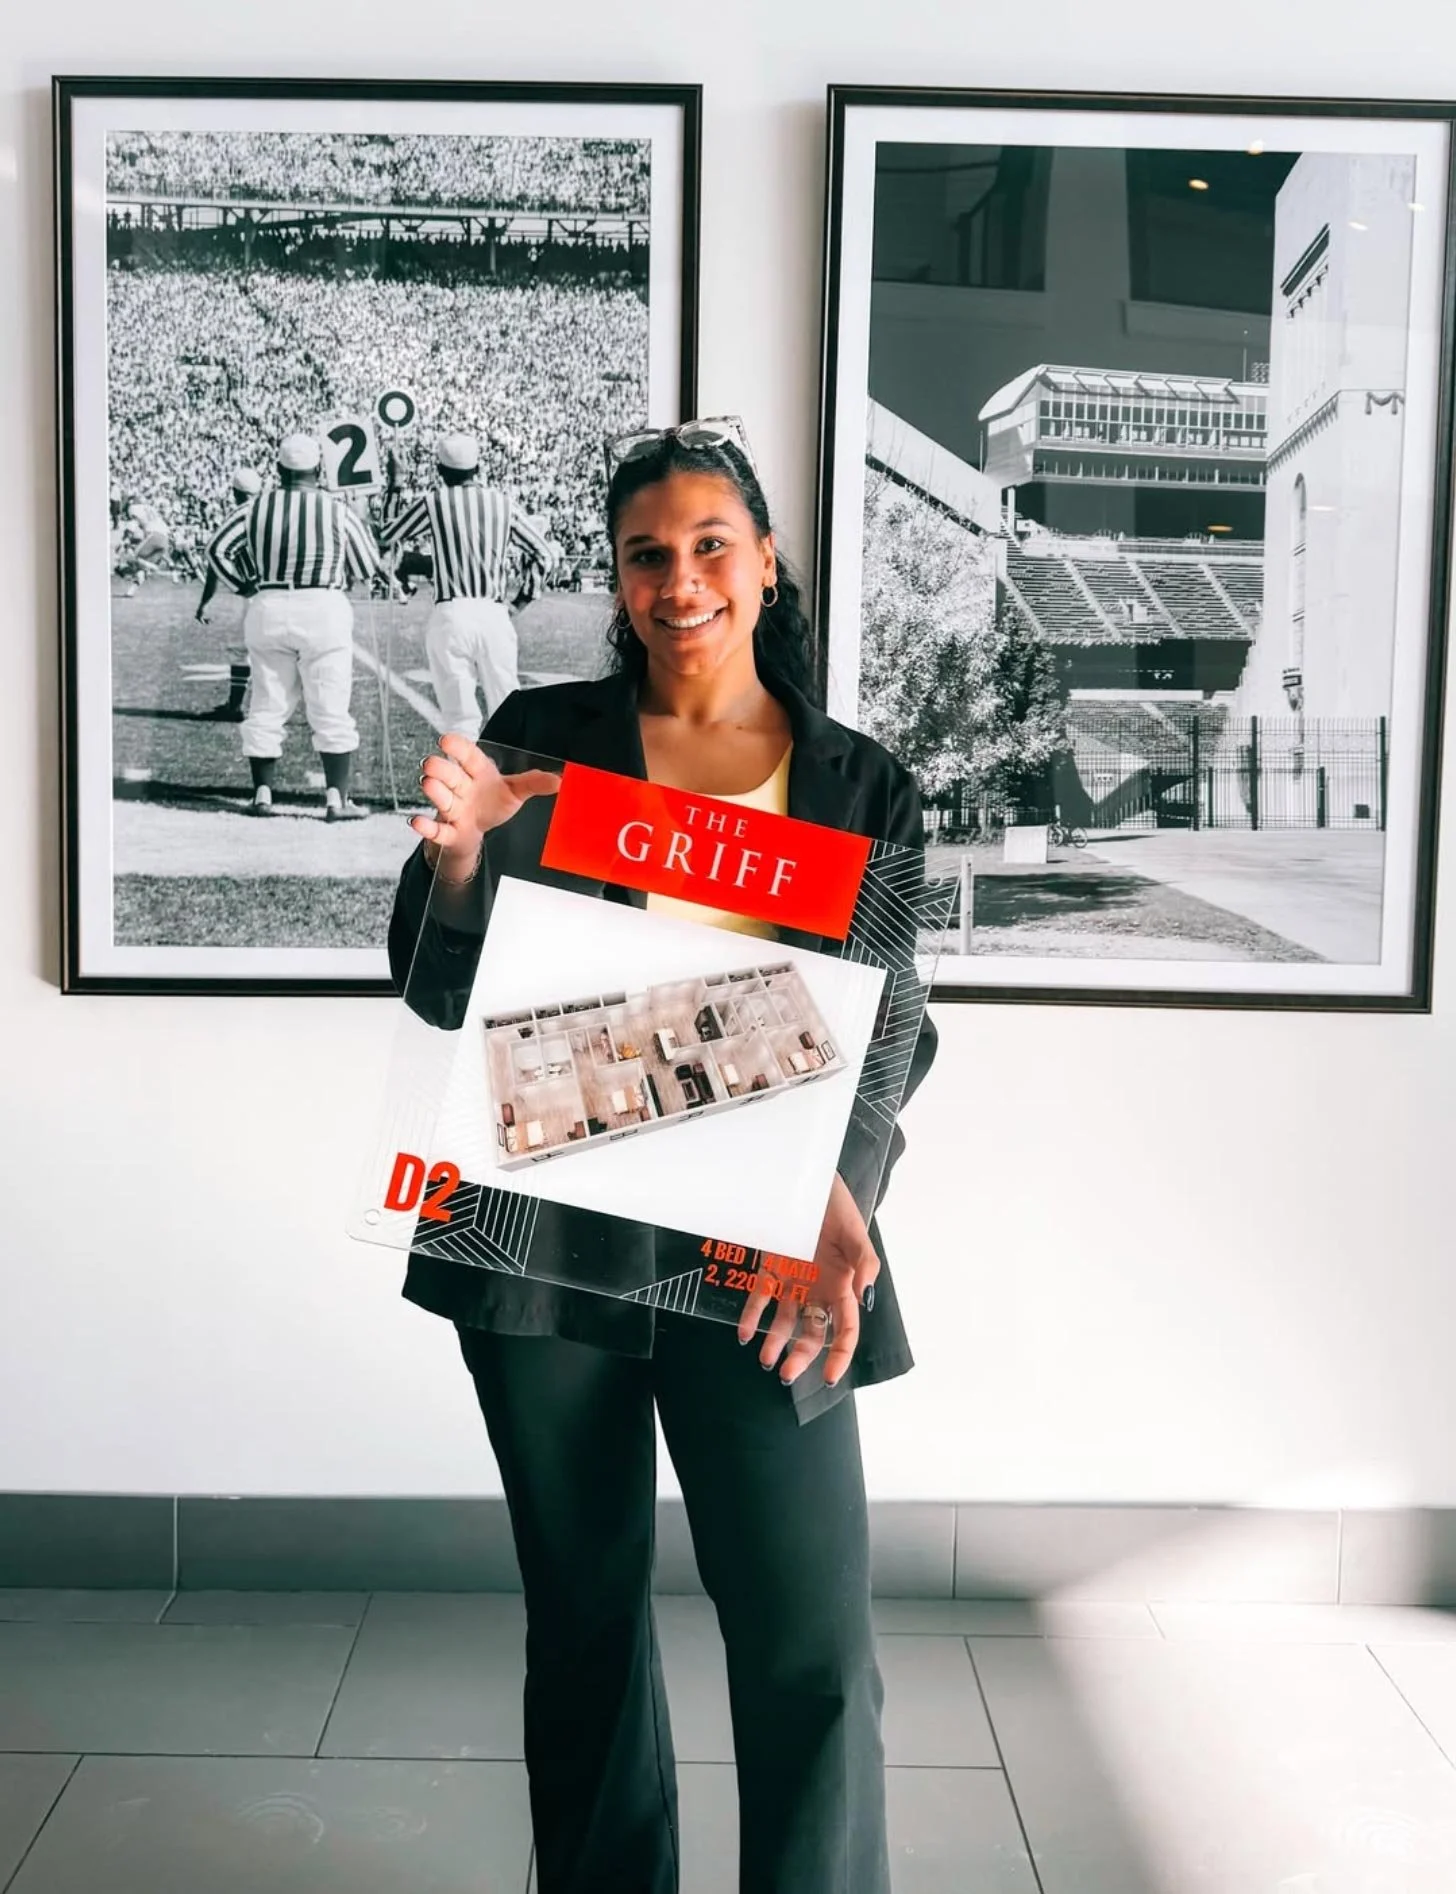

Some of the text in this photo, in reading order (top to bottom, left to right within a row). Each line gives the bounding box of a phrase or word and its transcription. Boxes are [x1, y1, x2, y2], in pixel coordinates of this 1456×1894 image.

[327, 424, 373, 487] 2
[685, 806, 748, 838] THE
[616, 821, 797, 897] GRIFF
[383, 1152, 461, 1222] D2
[701, 1239, 713, 1257] 4
[714, 1242, 746, 1265] BED
[763, 1253, 776, 1272] 4
[777, 1258, 819, 1283] BATH
